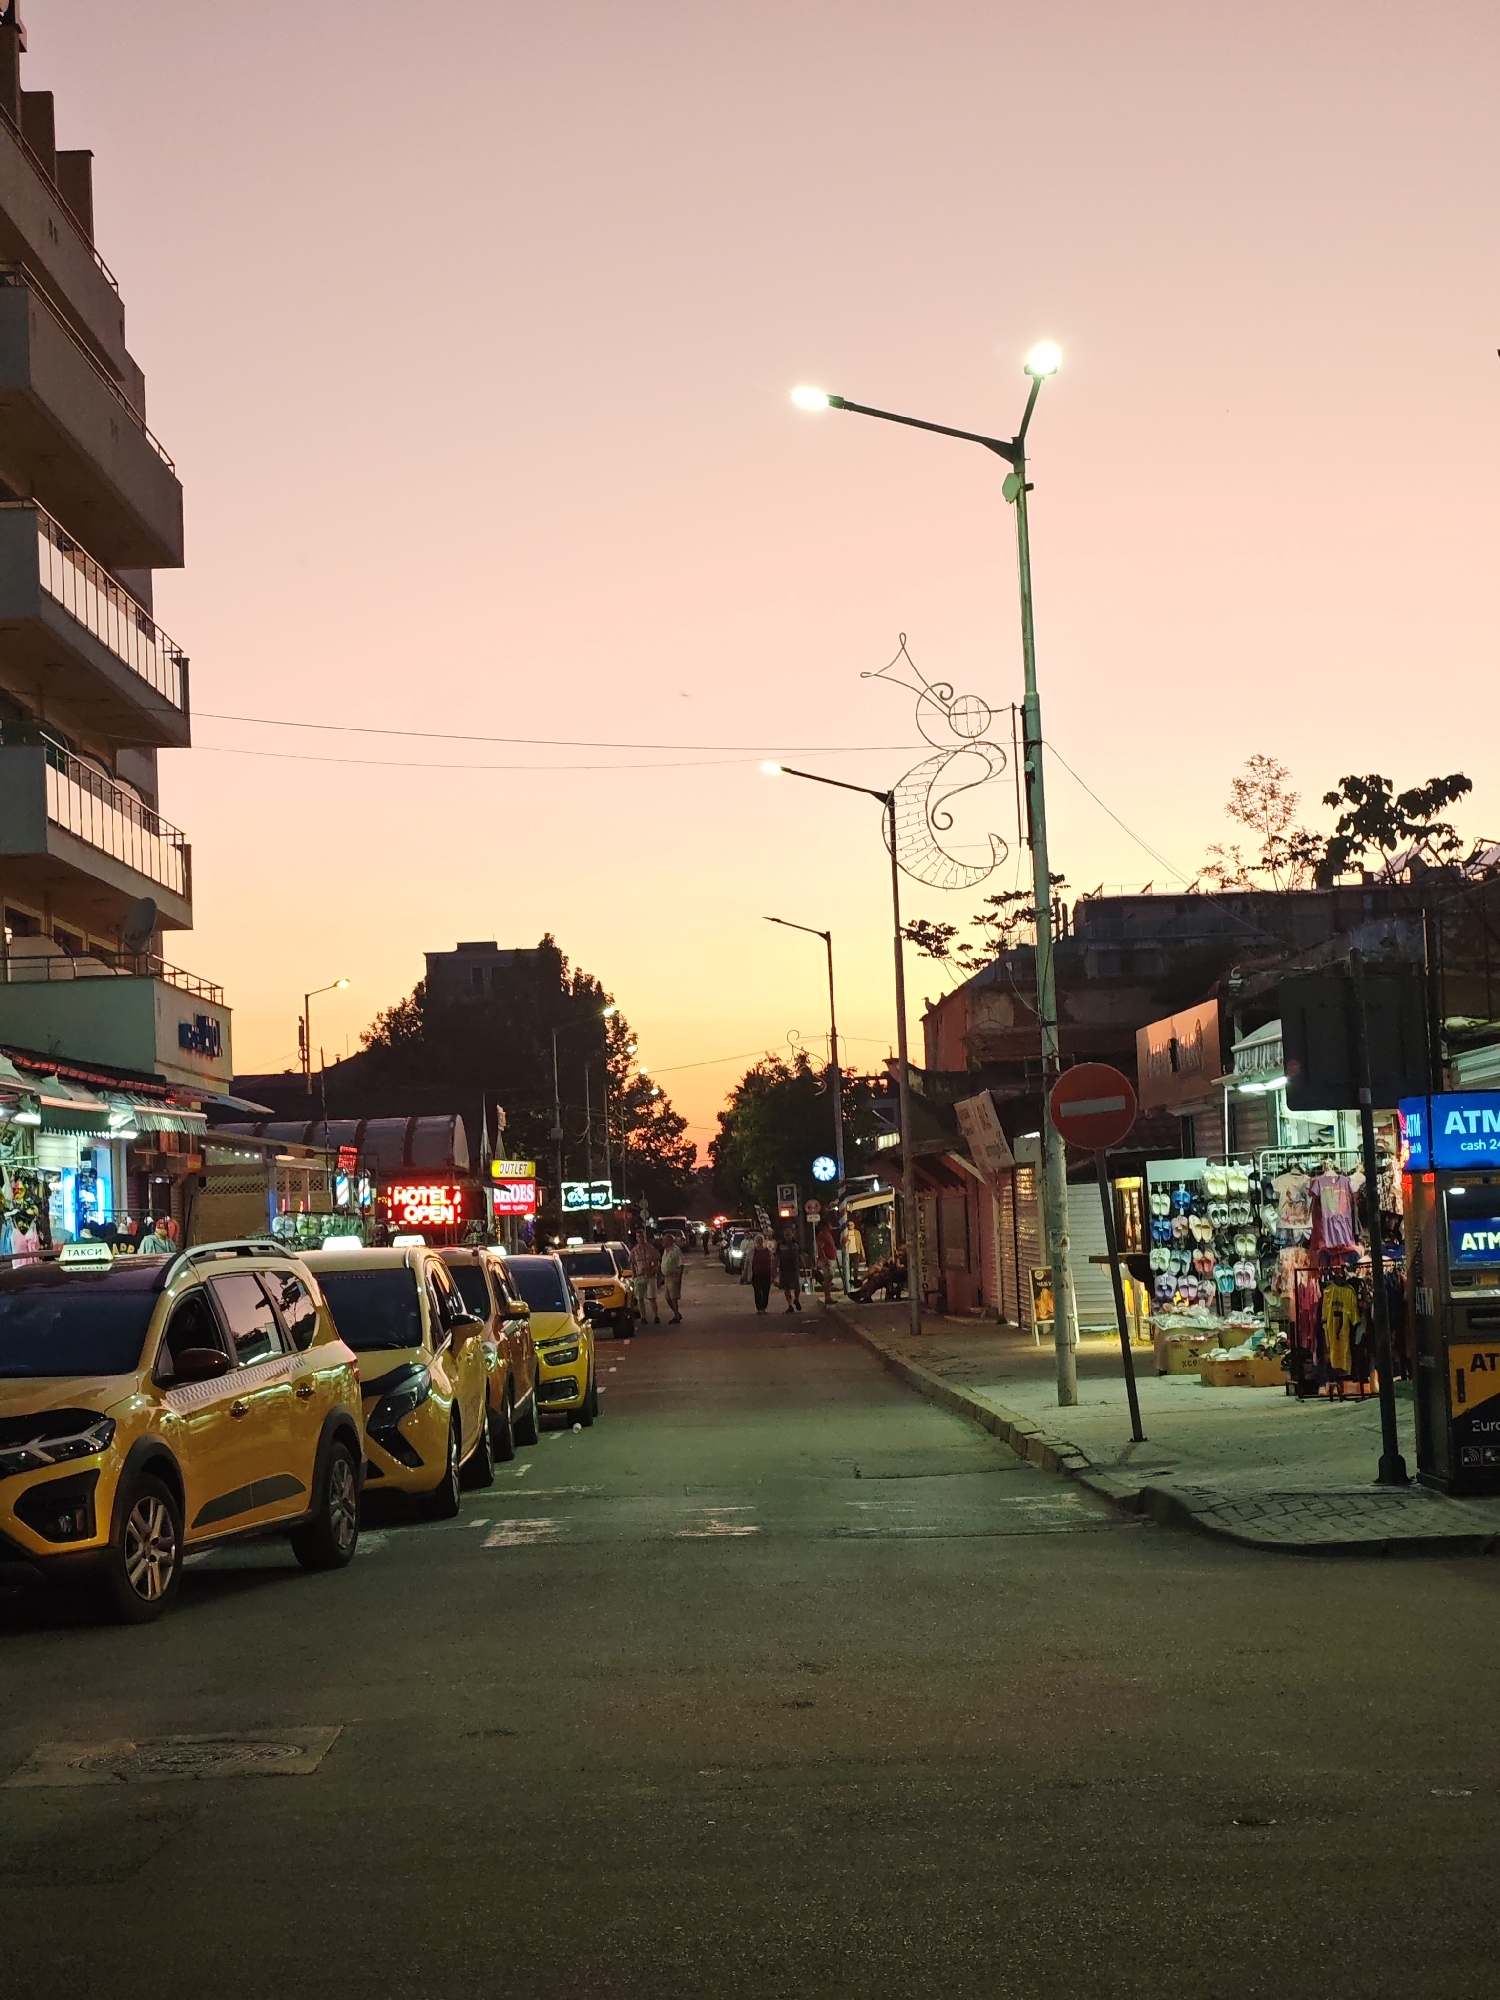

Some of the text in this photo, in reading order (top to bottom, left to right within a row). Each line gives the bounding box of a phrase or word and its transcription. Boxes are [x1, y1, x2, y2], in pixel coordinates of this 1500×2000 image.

[1406, 1113, 1420, 1137] ATM
[1444, 1110, 1500, 1135] ATM
[1460, 1139, 1486, 1151] cash
[499, 1163, 528, 1175] OUTLET
[393, 1188, 451, 1206] HOTEL
[494, 1183, 535, 1203] SHOES
[782, 1187, 792, 1200] P
[403, 1205, 455, 1221] OPEN
[512, 1203, 529, 1212] quality
[1461, 1231, 1500, 1251] ATM
[66, 1248, 103, 1257] ТАКСИ
[1415, 1286, 1434, 1316] ATM
